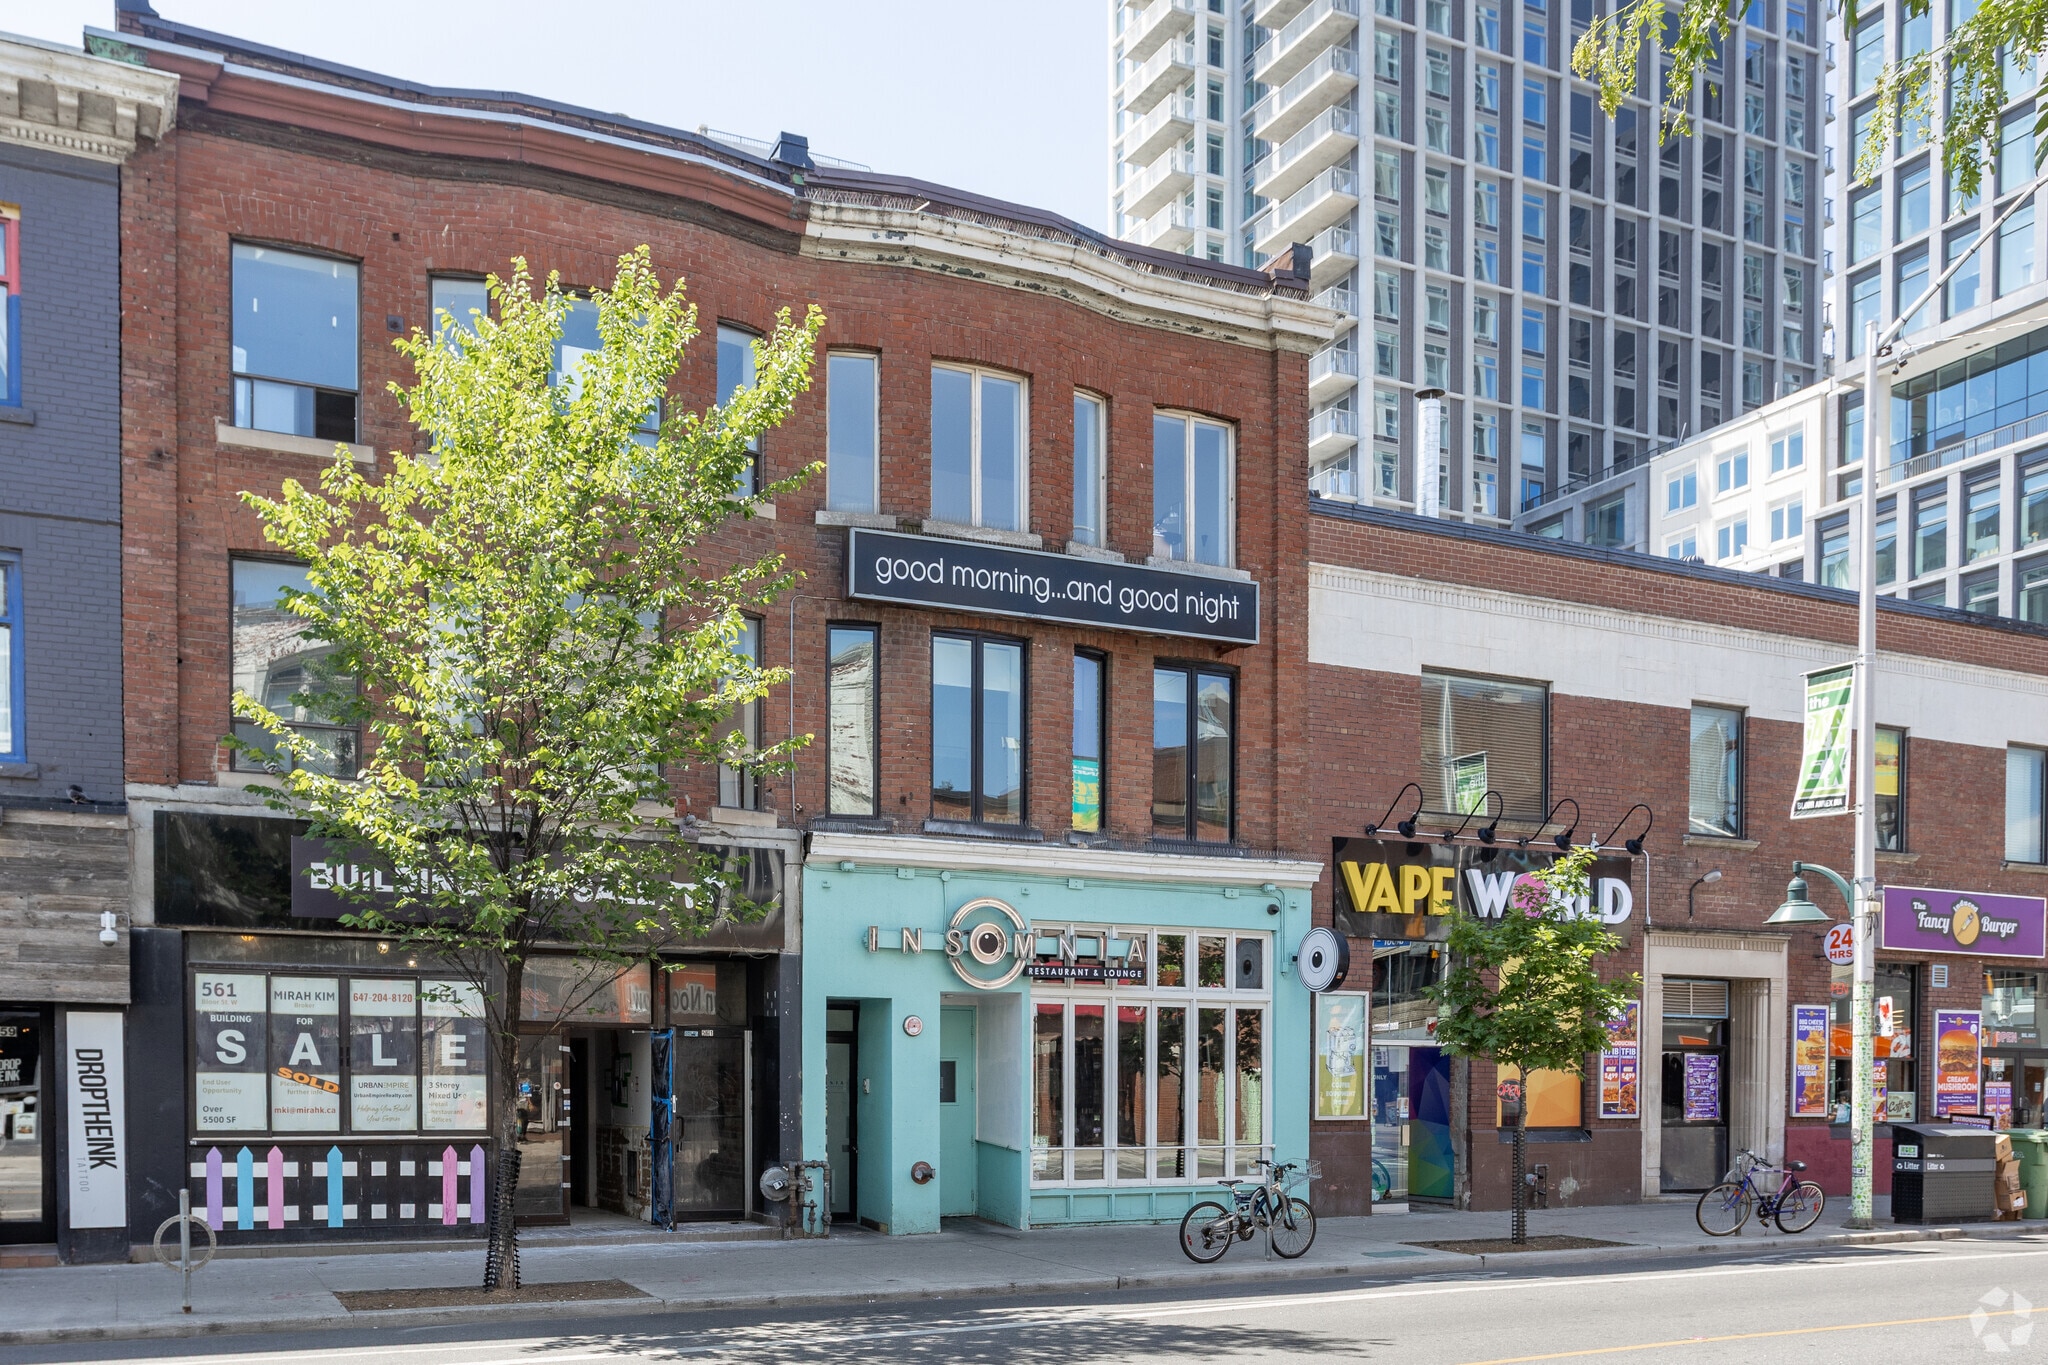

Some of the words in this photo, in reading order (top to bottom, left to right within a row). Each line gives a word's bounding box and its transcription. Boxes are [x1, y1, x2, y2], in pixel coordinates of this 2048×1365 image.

[875, 556, 944, 584] good
[1120, 586, 1178, 614] good
[1186, 590, 1240, 624] night
[1808, 695, 1830, 711] the
[1341, 861, 1455, 916] VAPE
[1912, 901, 1927, 911] The
[1918, 911, 1950, 934] Fancy
[1981, 916, 2018, 938] Burger
[868, 923, 1147, 963] INSOMNIA
[1830, 930, 1853, 949] 24
[1829, 950, 1853, 959] HRS
[1028, 967, 1089, 977] RESTAURANT
[1093, 968, 1100, 977] &
[1104, 969, 1142, 978] LOUNGE
[202, 982, 236, 997] 561
[1831, 982, 1849, 995] PEN
[274, 991, 311, 1001] MIRAH
[315, 992, 335, 1001] KIM
[353, 993, 413, 1003] 647-204-8120
[428, 989, 458, 1002] 561
[0, 1027, 15, 1036] 59
[277, 1066, 340, 1094] SOLD
[435, 1082, 460, 1090] Storey
[1497, 1084, 1520, 1097] OPEN
[1938, 1083, 1977, 1091] MUSHROOM
[274, 1106, 336, 1114] mki@mirahk.ca
[1889, 1100, 1912, 1113] Coffee
[1904, 1162, 1919, 1170] Litter
[1927, 1162, 1938, 1170] Litter
[77, 1157, 90, 1193] TATTOO
